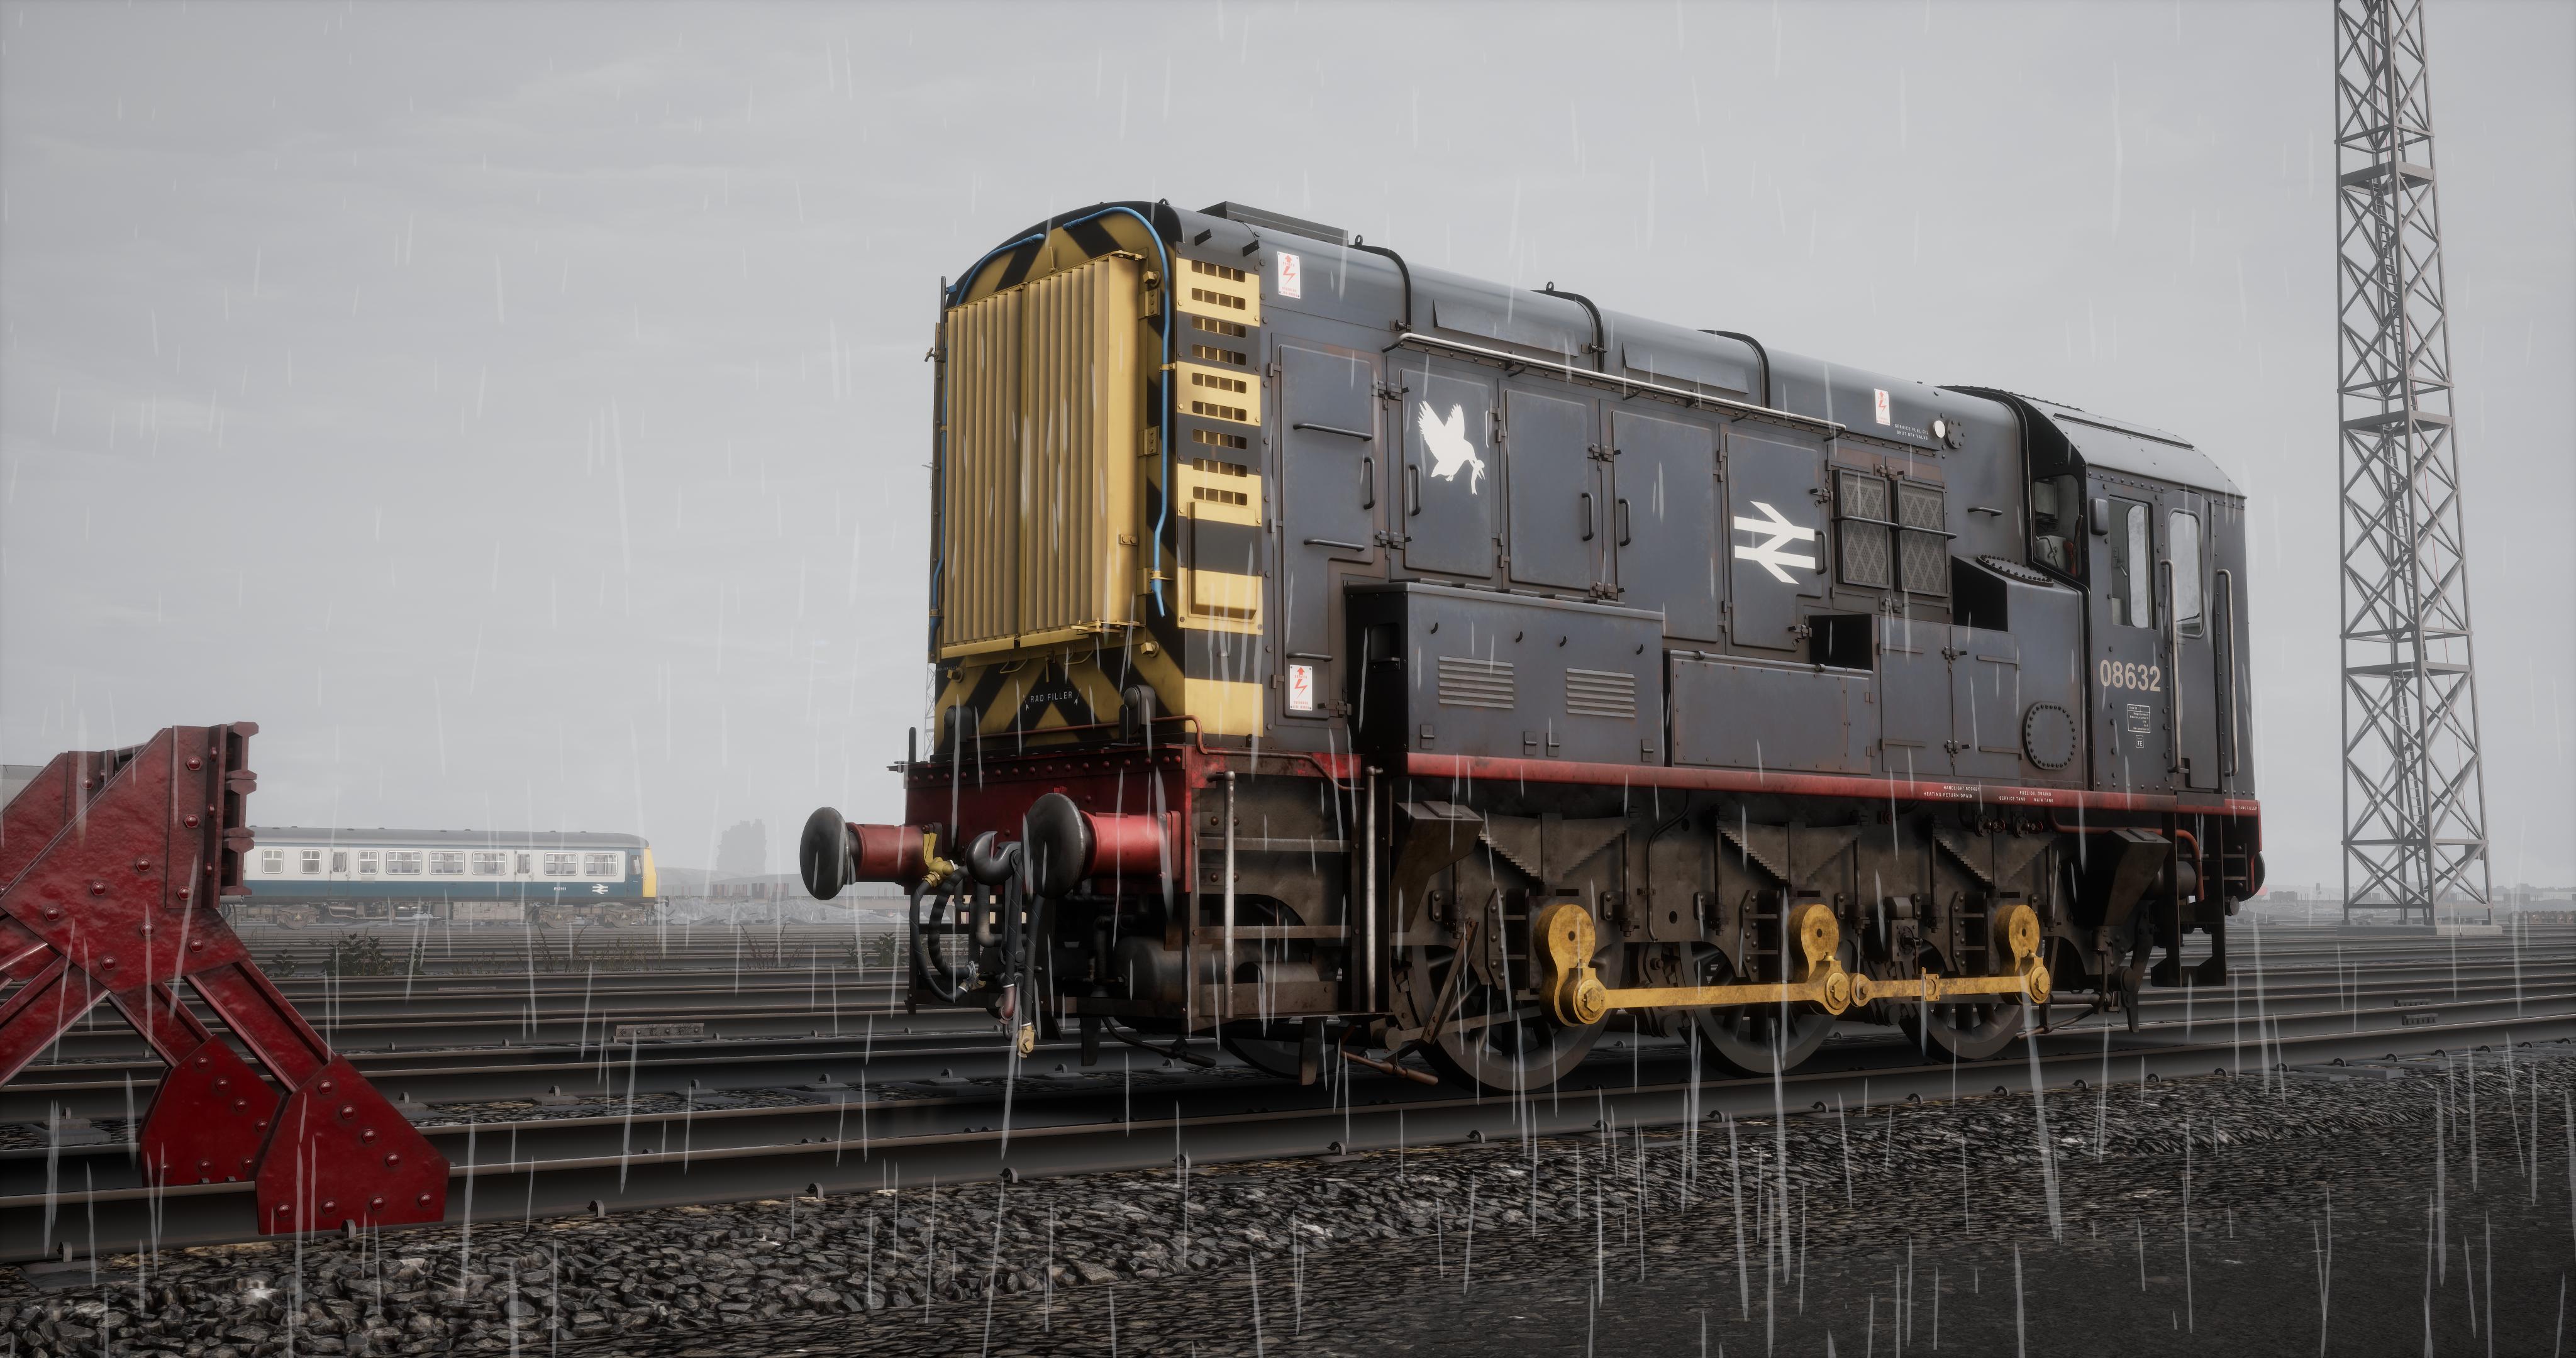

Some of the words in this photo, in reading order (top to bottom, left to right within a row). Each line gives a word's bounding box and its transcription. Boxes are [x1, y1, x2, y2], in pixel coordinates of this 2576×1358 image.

[2099, 660, 2161, 692] 08632
[1030, 694, 1044, 703] RAD
[1047, 691, 1072, 701] FILLER
